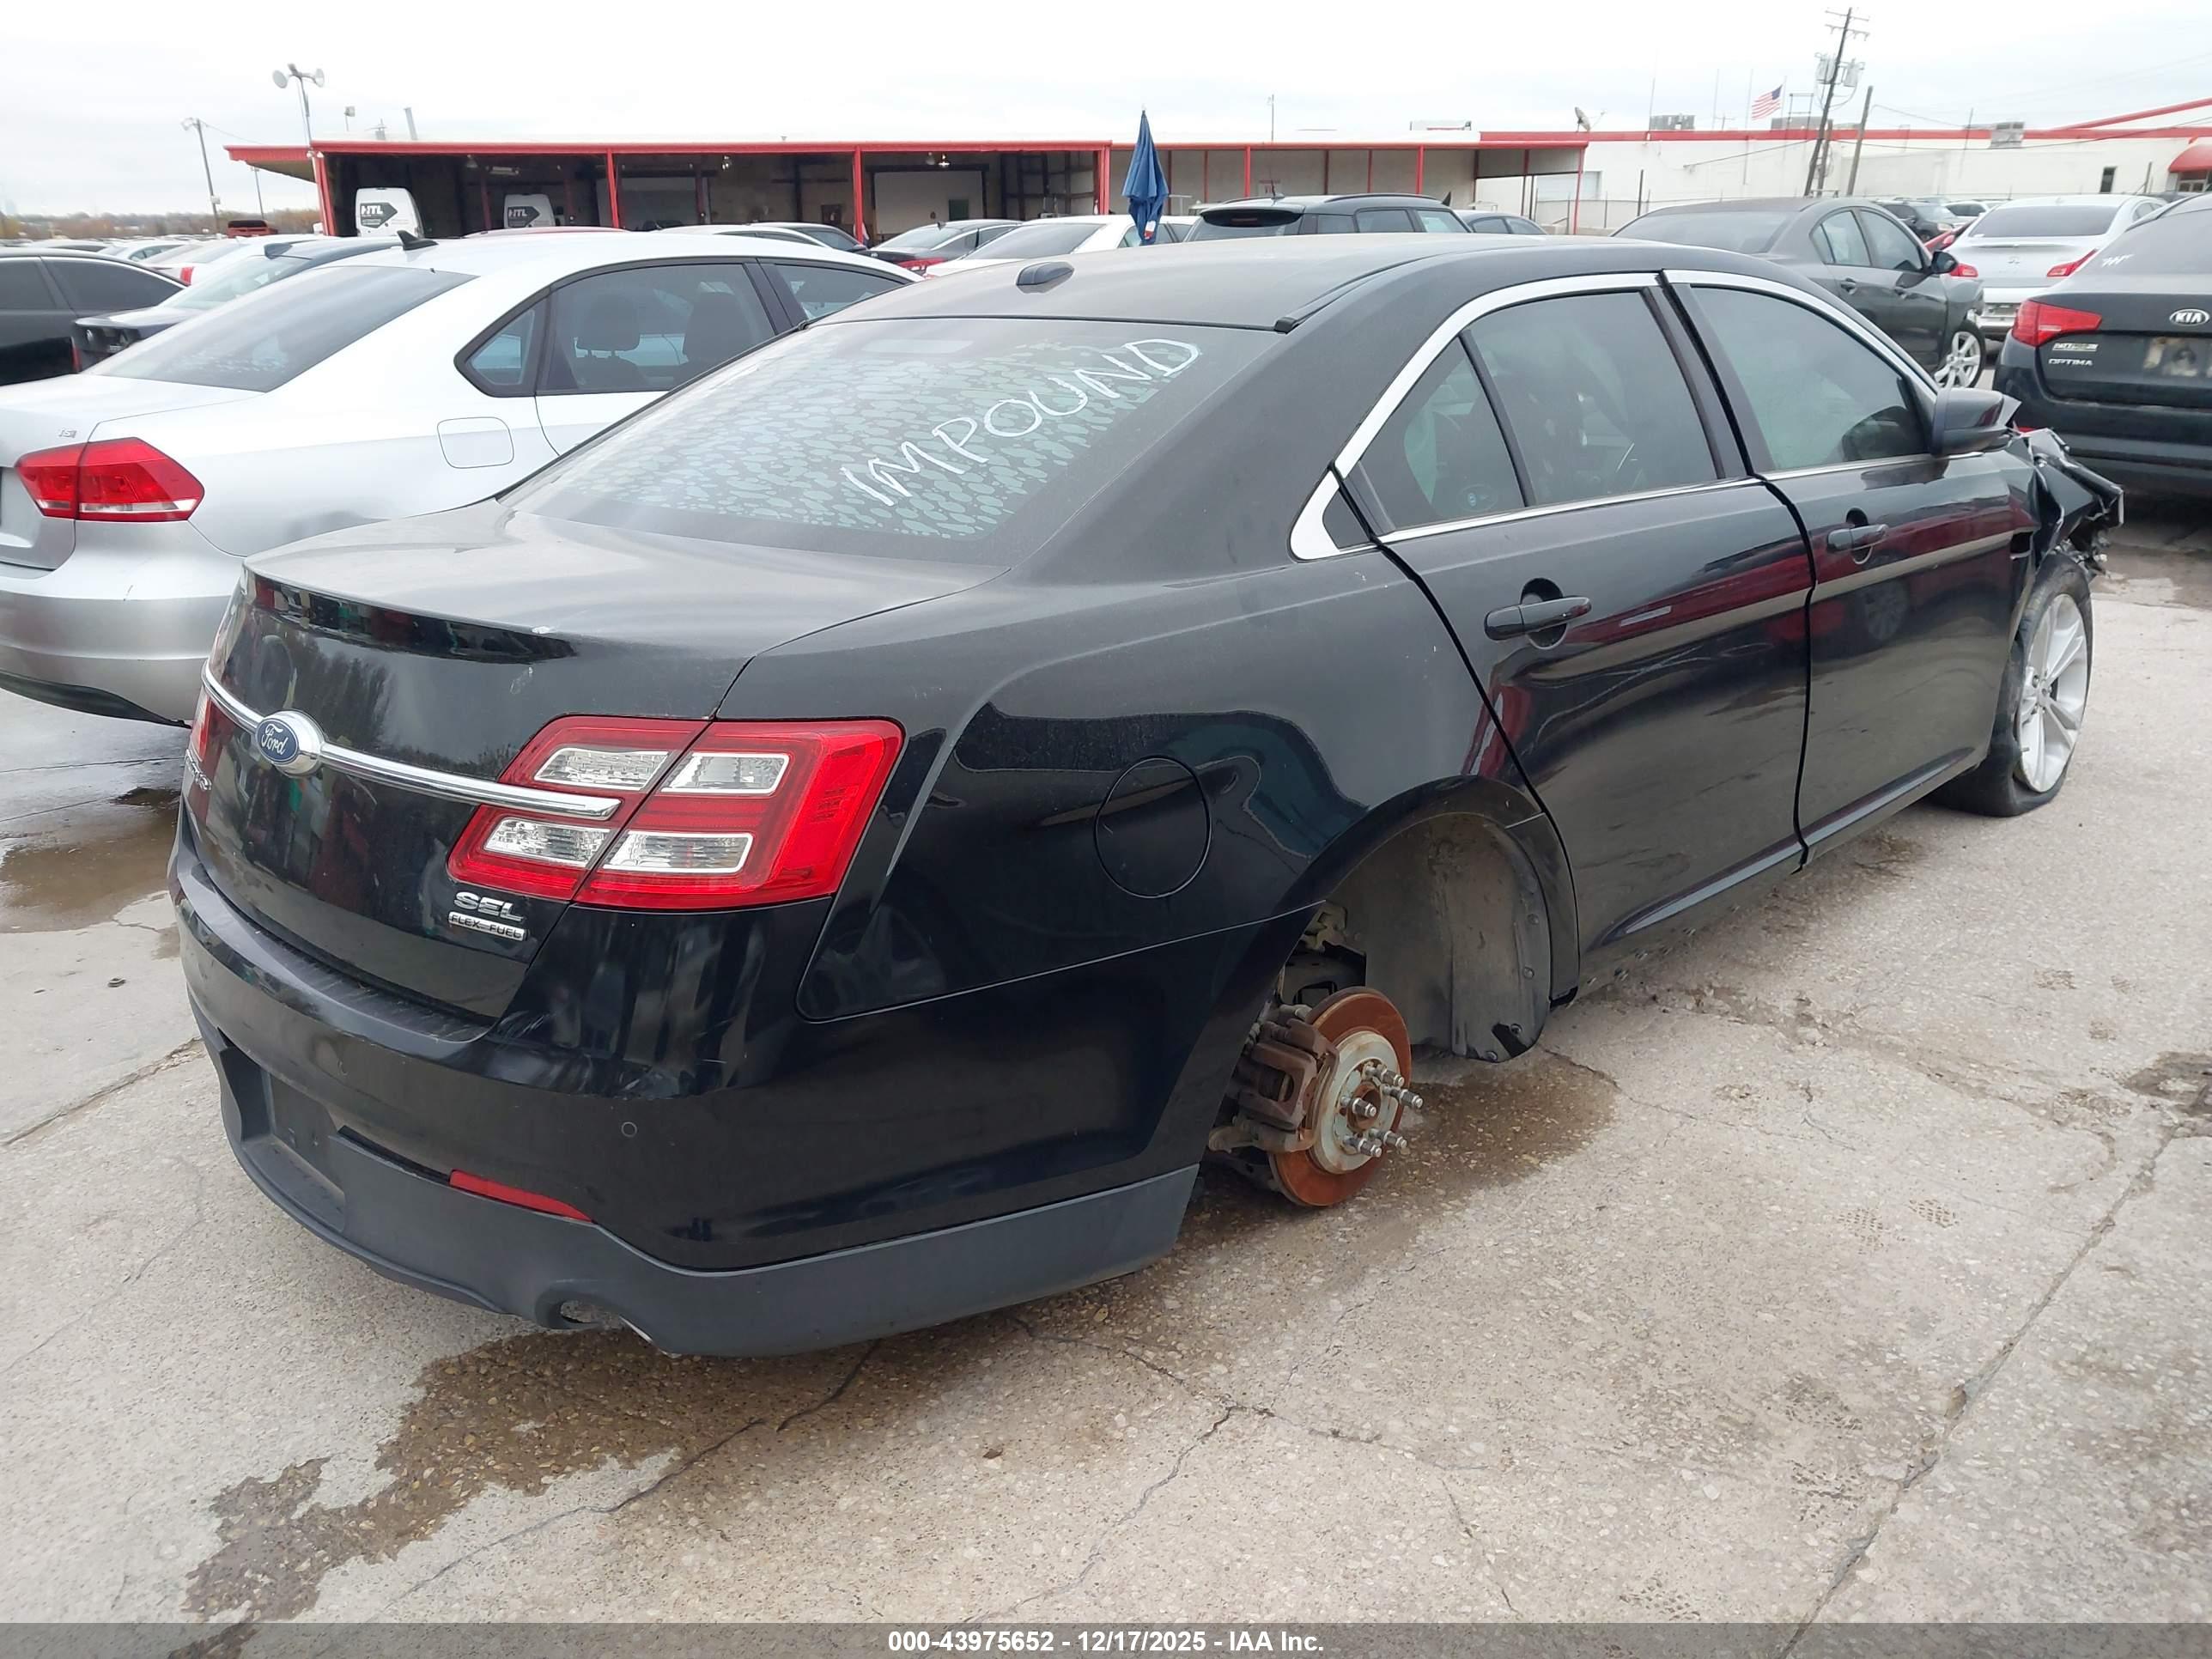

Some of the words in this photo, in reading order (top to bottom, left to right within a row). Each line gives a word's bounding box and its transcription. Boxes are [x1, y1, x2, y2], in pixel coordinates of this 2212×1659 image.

[839, 338, 1201, 507] IMPOUND
[261, 723, 289, 756] Ford
[453, 891, 525, 922] SEL
[451, 914, 480, 929] FLEX
[489, 924, 523, 939] FUEL
